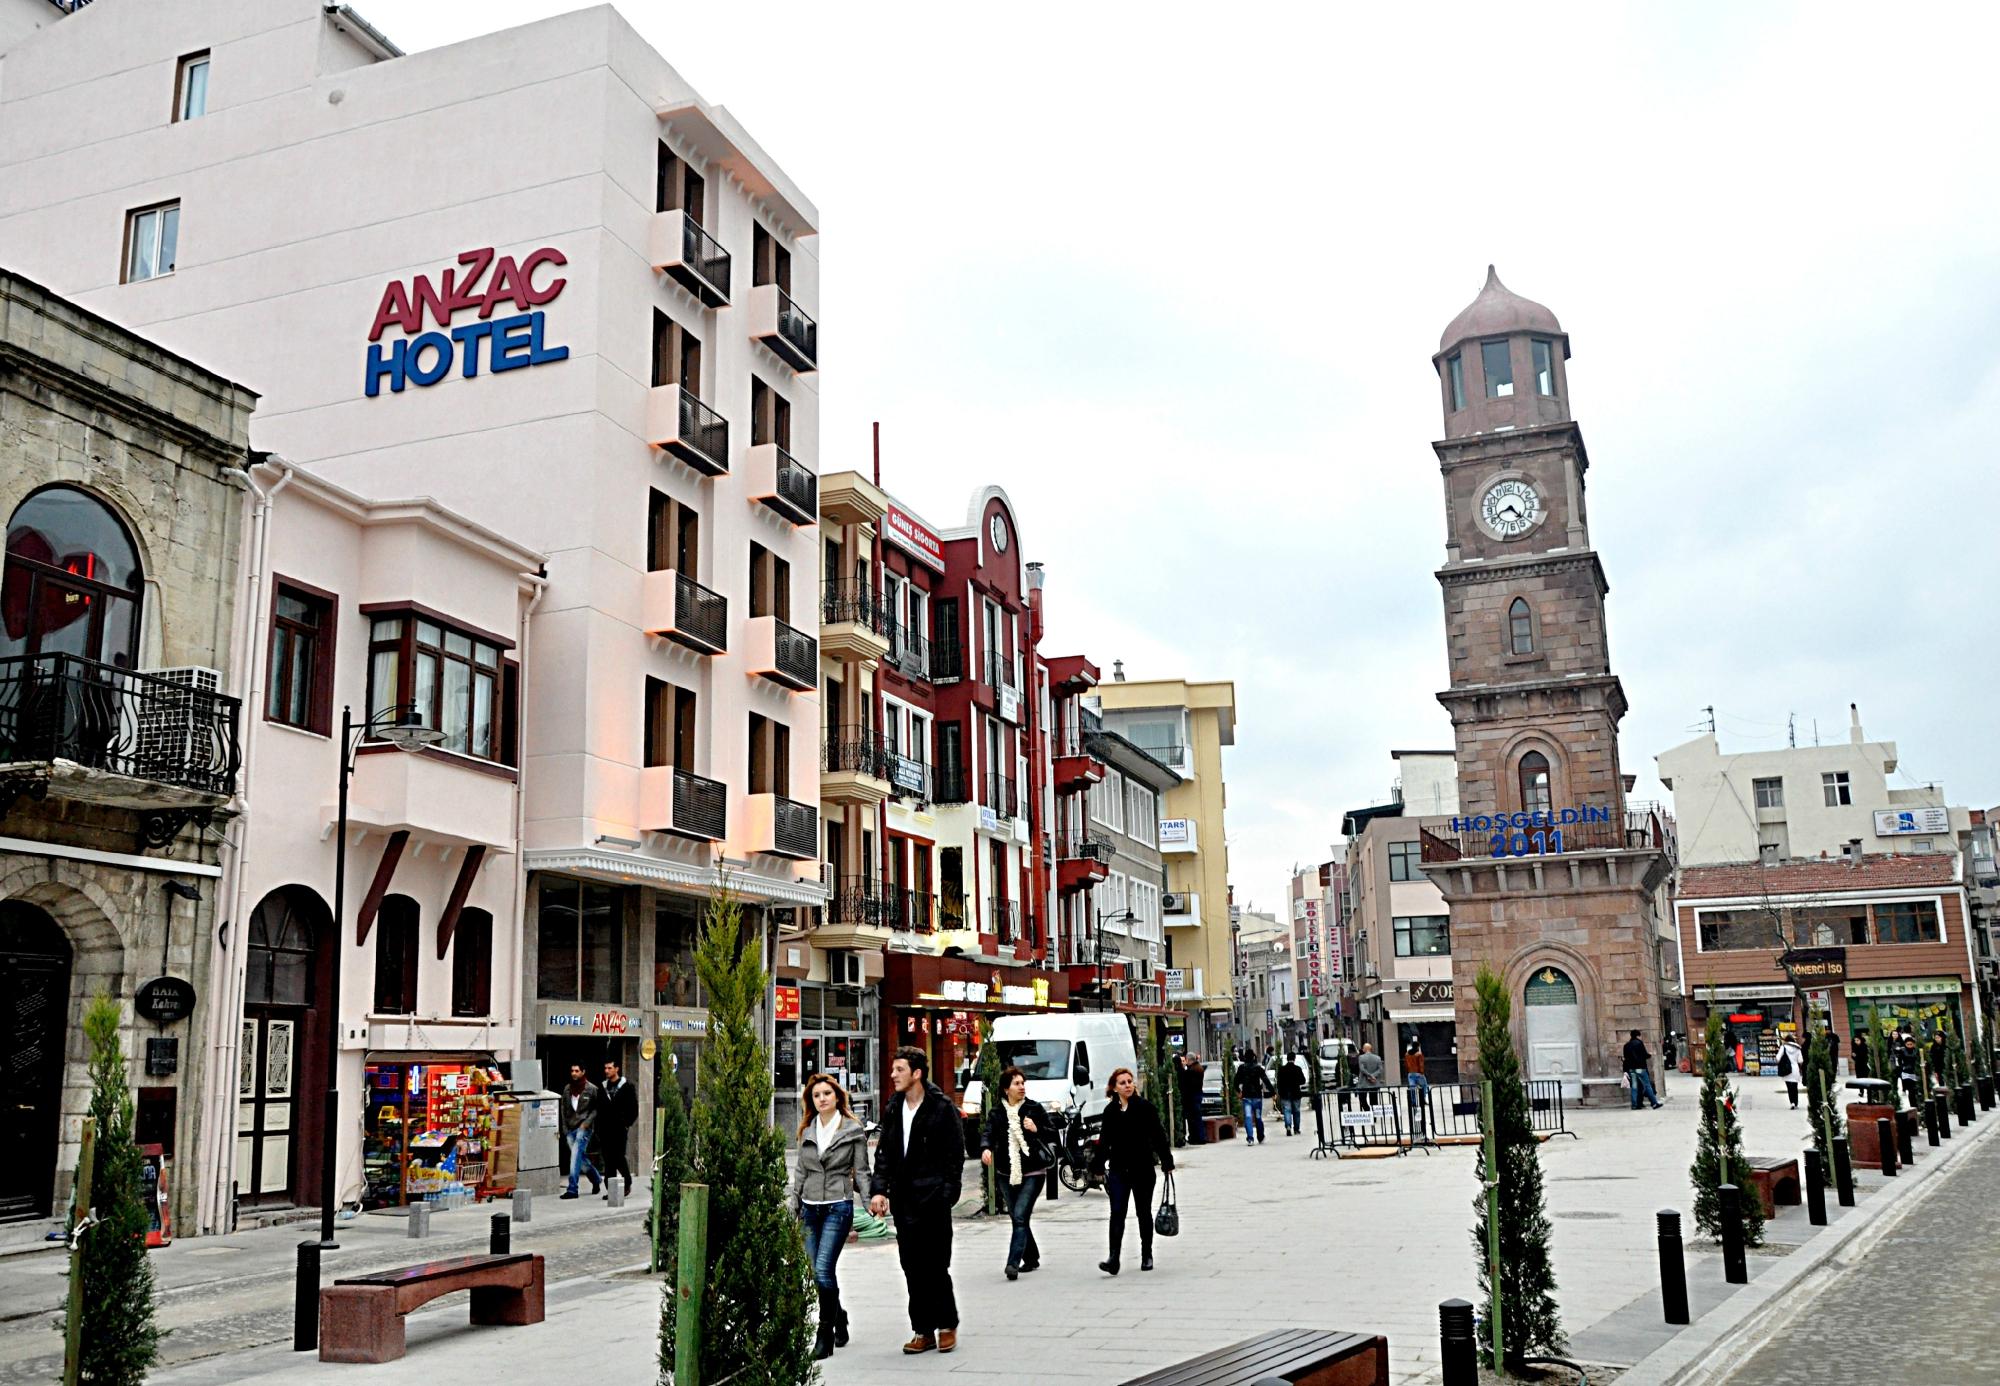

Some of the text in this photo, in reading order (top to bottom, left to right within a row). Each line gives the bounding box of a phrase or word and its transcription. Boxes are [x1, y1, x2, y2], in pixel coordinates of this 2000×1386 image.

[368, 247, 567, 342] ANZAC
[365, 311, 569, 398] HOTEL
[892, 513, 913, 538] GÜNEŞ
[1452, 803, 1610, 833] HOŞGELDİN
[1488, 829, 1564, 859] 2011
[1305, 901, 1318, 943] HOTEL
[1309, 953, 1321, 997] KONAK
[1412, 982, 1429, 1001] ÖZEL
[550, 1015, 585, 1026] HOTEL
[592, 1011, 627, 1034] ANZAC
